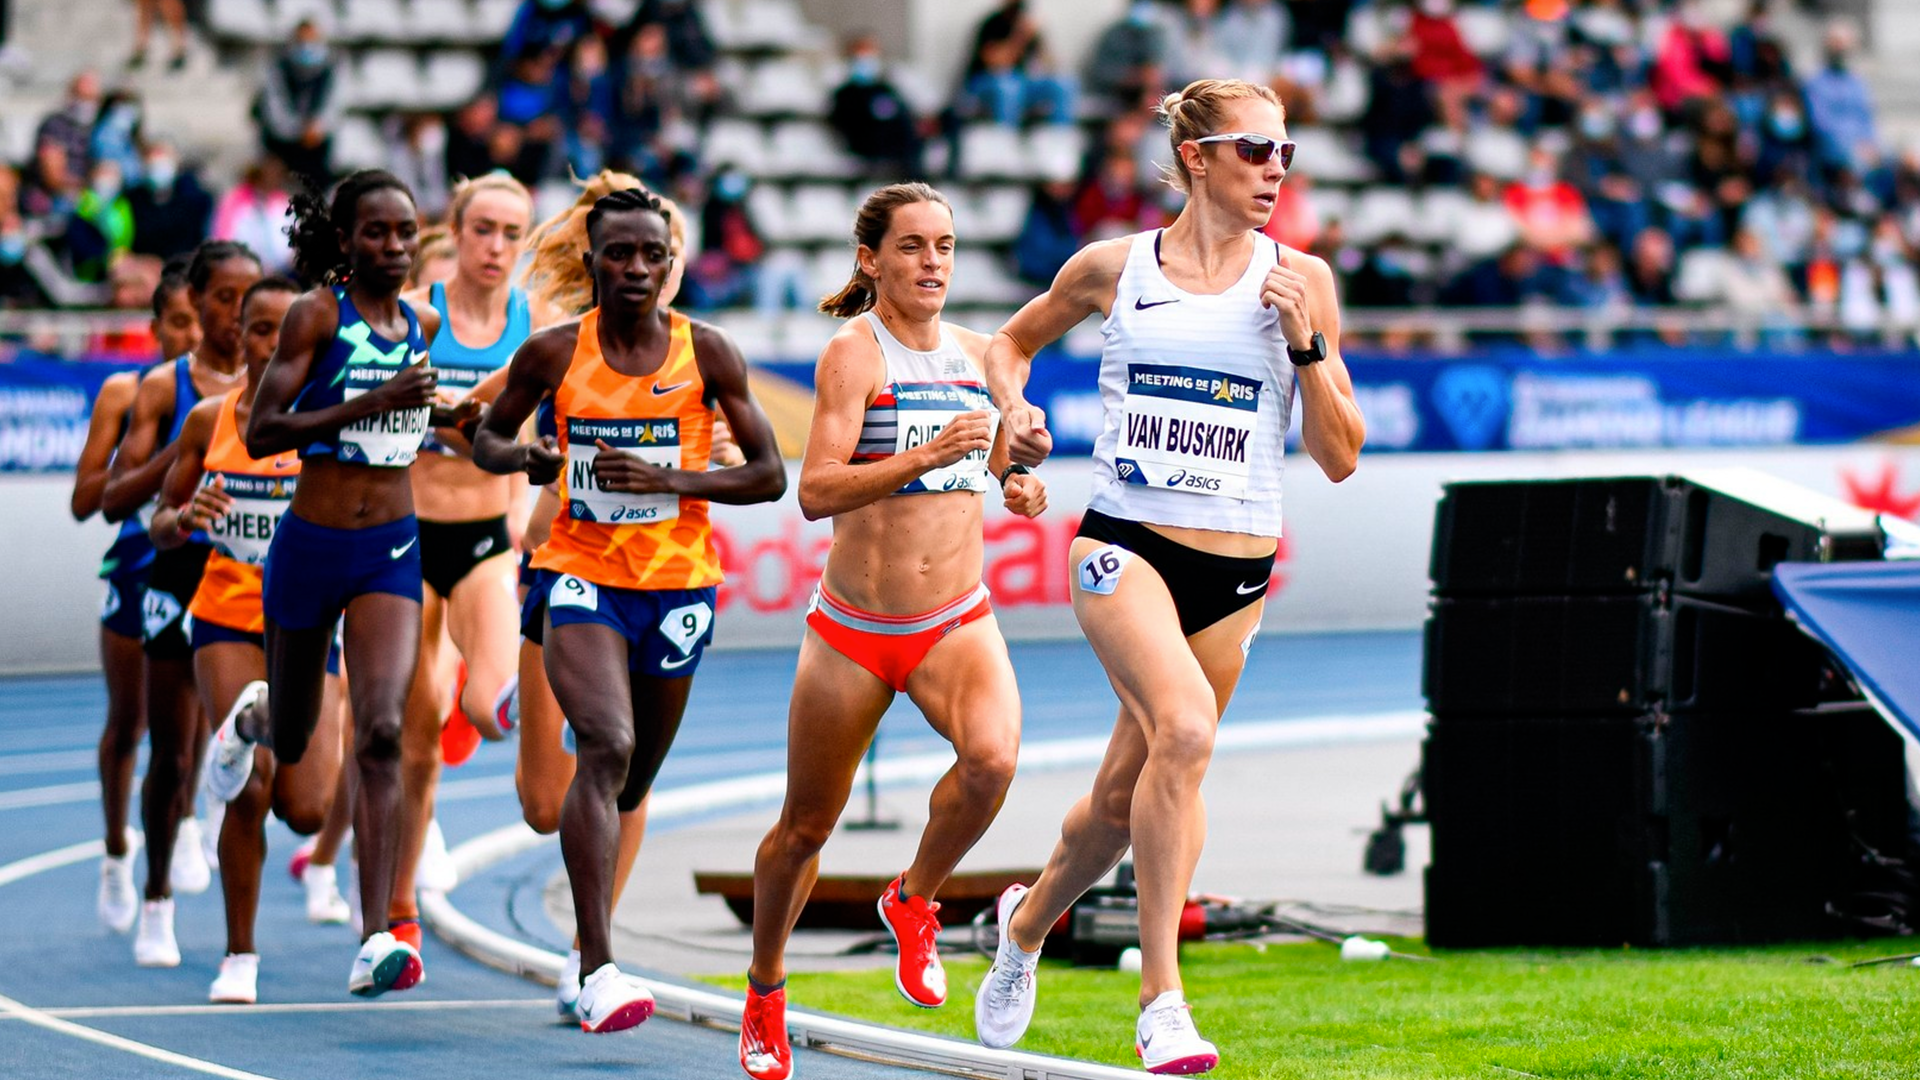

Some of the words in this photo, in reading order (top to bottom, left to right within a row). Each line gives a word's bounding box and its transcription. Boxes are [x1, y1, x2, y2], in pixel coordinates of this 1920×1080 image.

[897, 390, 946, 401] MEETING
[1134, 373, 1193, 388] MEETING
[1195, 379, 1209, 391] DE
[1210, 378, 1255, 402] PARIS
[571, 424, 619, 437] MEETING
[621, 426, 632, 437] DE
[635, 422, 676, 443] PARIS
[1127, 412, 1162, 449] VAN
[1166, 418, 1250, 463] BUSKIRK
[1085, 551, 1120, 587] 16
[565, 577, 586, 596] 9
[682, 613, 697, 637] 9
